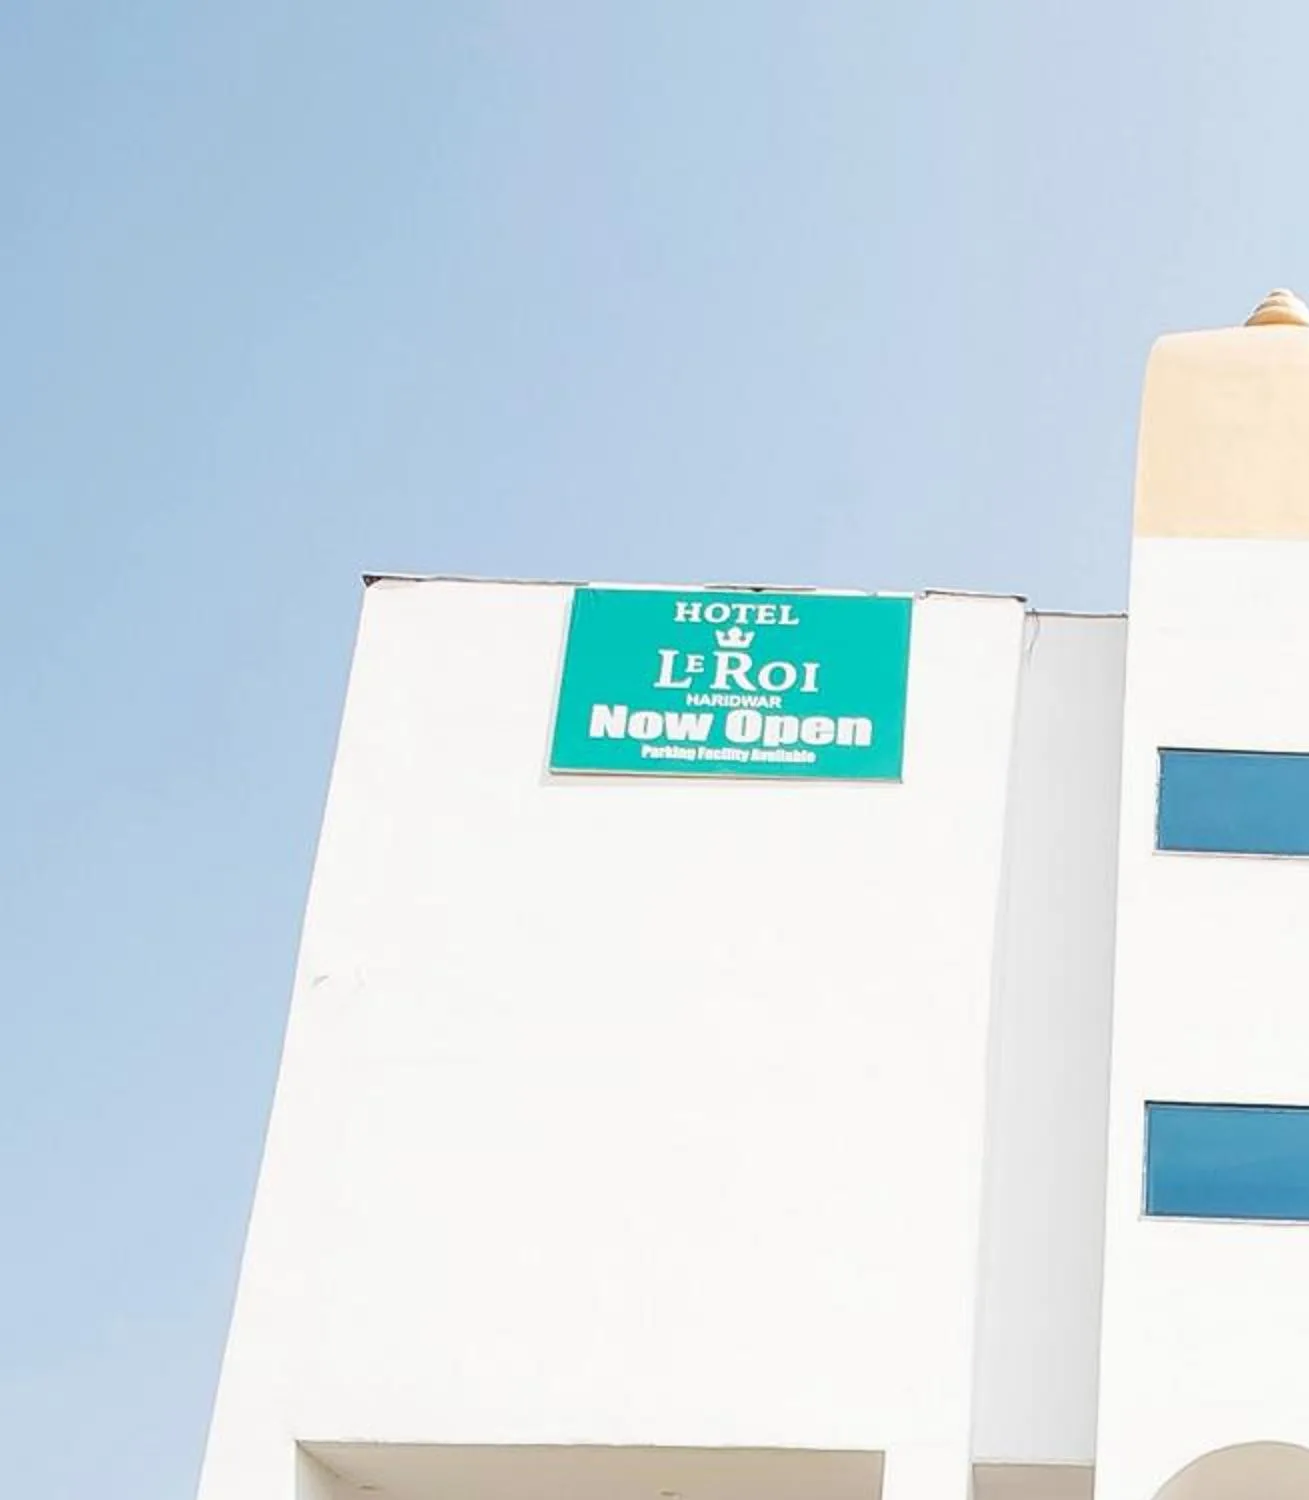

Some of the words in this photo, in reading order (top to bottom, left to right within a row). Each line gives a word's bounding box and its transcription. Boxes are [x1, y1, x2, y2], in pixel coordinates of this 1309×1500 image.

[674, 601, 800, 625] HOTEL
[686, 693, 782, 708] HARIDWAR
[589, 704, 714, 741] Now
[724, 708, 873, 747] Open
